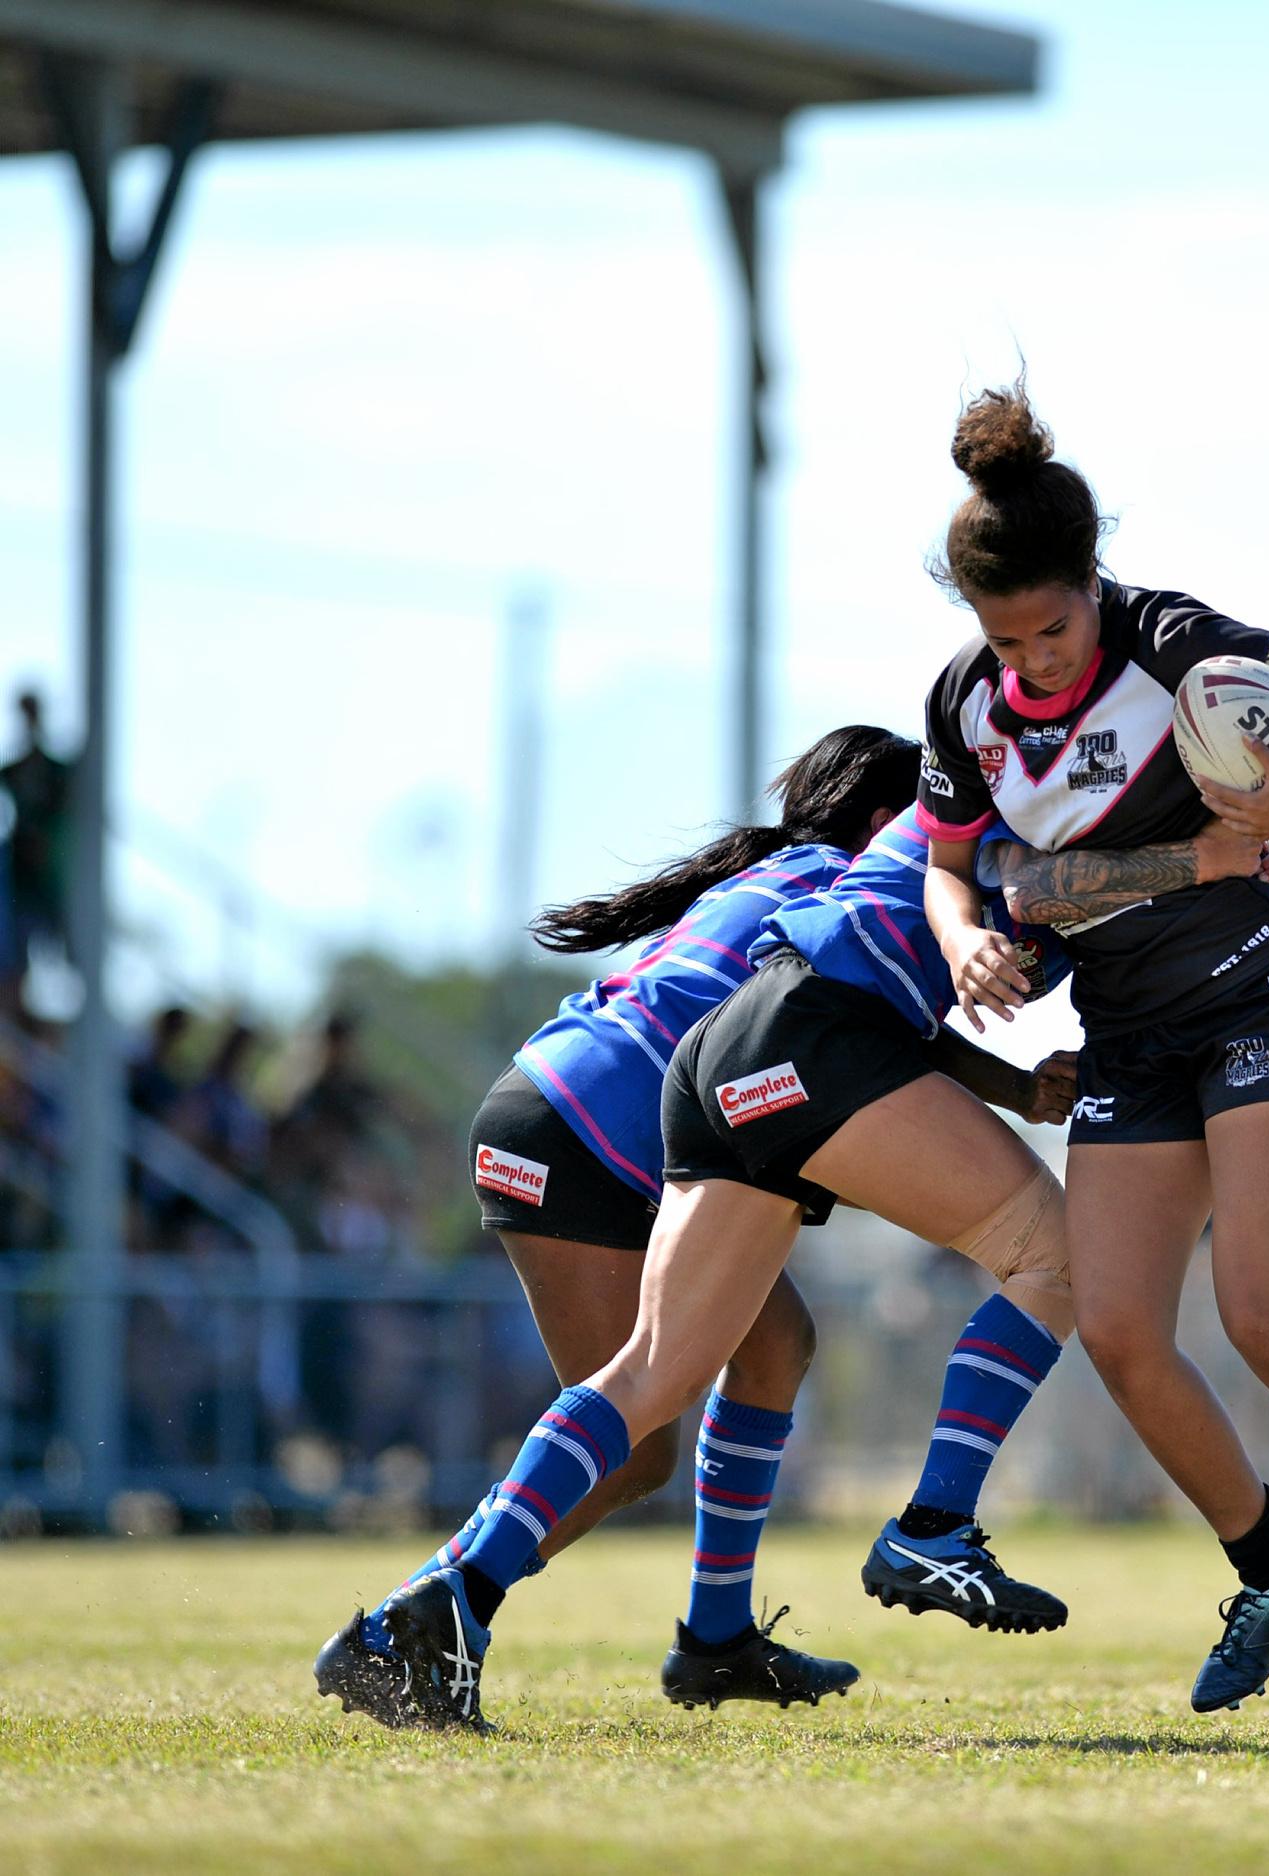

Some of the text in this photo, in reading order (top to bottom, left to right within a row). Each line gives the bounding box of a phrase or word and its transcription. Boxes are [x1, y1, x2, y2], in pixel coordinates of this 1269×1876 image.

[1067, 763, 1128, 791] MAGPIES
[720, 1075, 797, 1111] Complete
[770, 1094, 804, 1111] SUPPORT
[478, 1149, 543, 1188] Complete
[510, 1189, 539, 1203] SUPPORT
